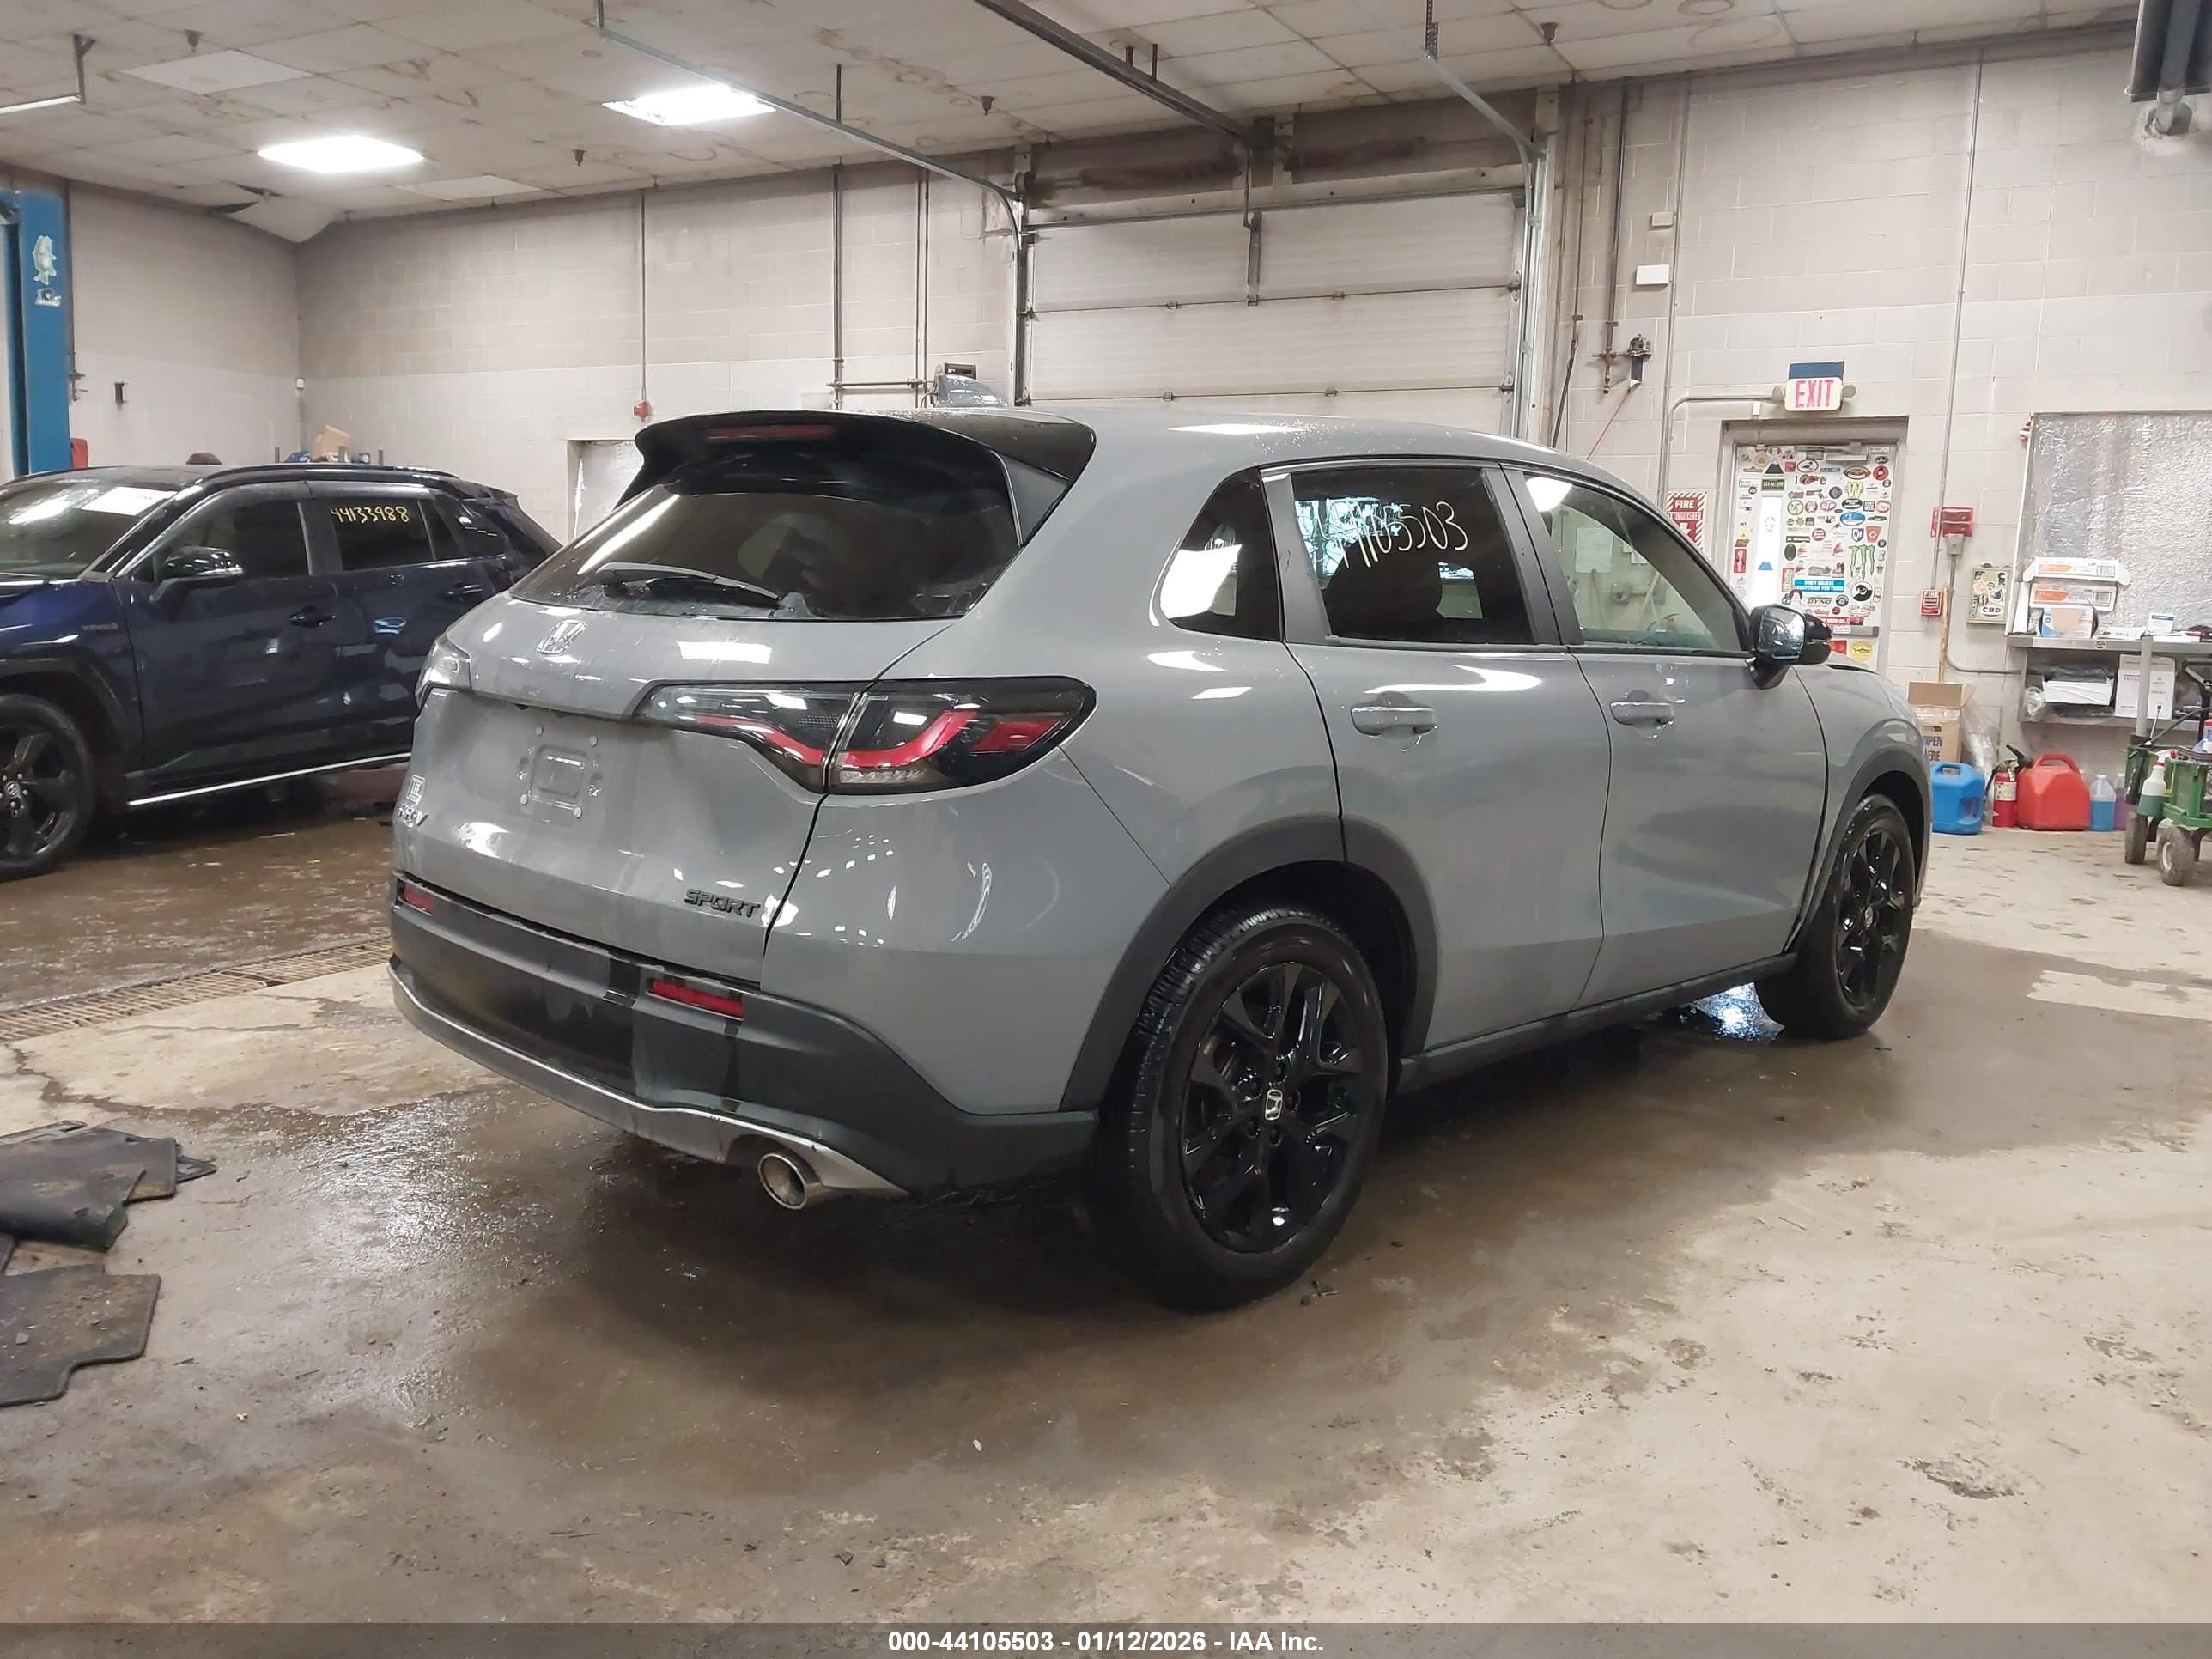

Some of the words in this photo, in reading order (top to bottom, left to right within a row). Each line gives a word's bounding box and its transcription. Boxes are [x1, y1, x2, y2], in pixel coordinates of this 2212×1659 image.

[1795, 380, 1834, 408] EXIT
[1674, 500, 1695, 509] FIRE
[684, 889, 761, 918] SPORT
